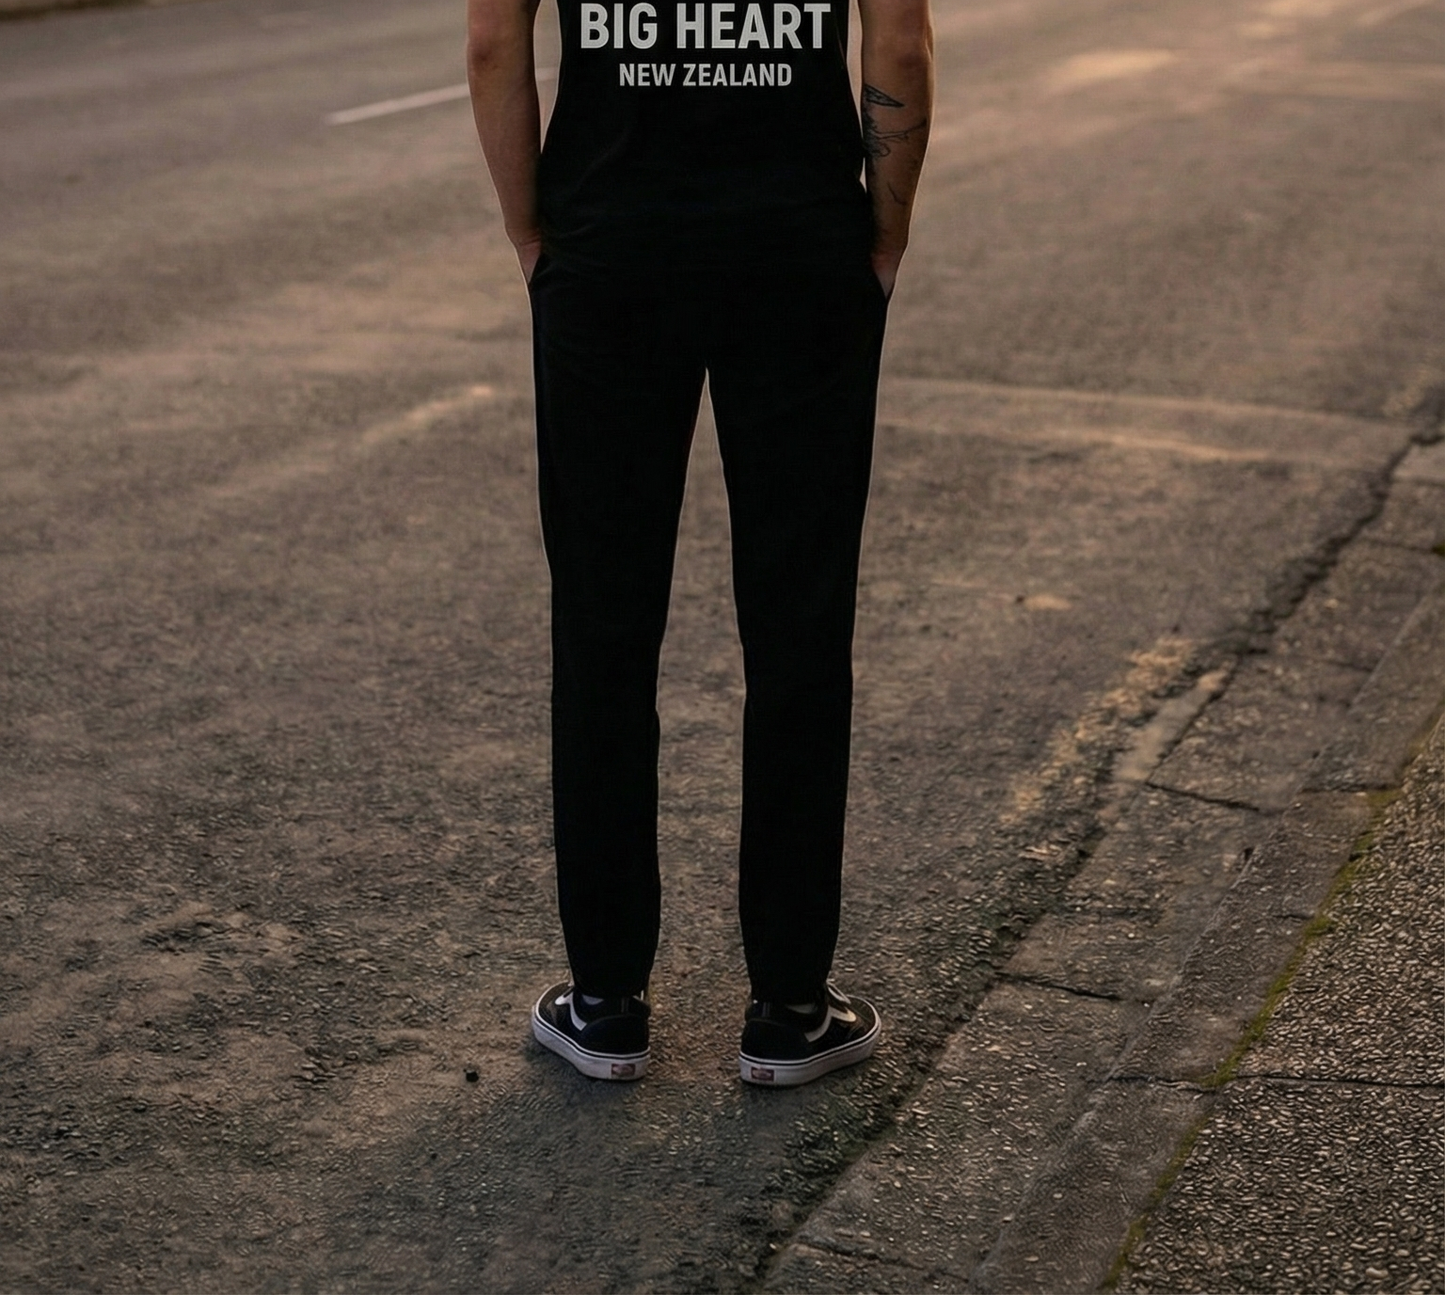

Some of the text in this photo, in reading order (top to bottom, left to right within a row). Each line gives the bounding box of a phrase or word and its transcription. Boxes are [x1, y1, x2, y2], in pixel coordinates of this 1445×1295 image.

[581, 3, 830, 49] BIG HEART
[620, 64, 791, 86] NEW ZEALAND
